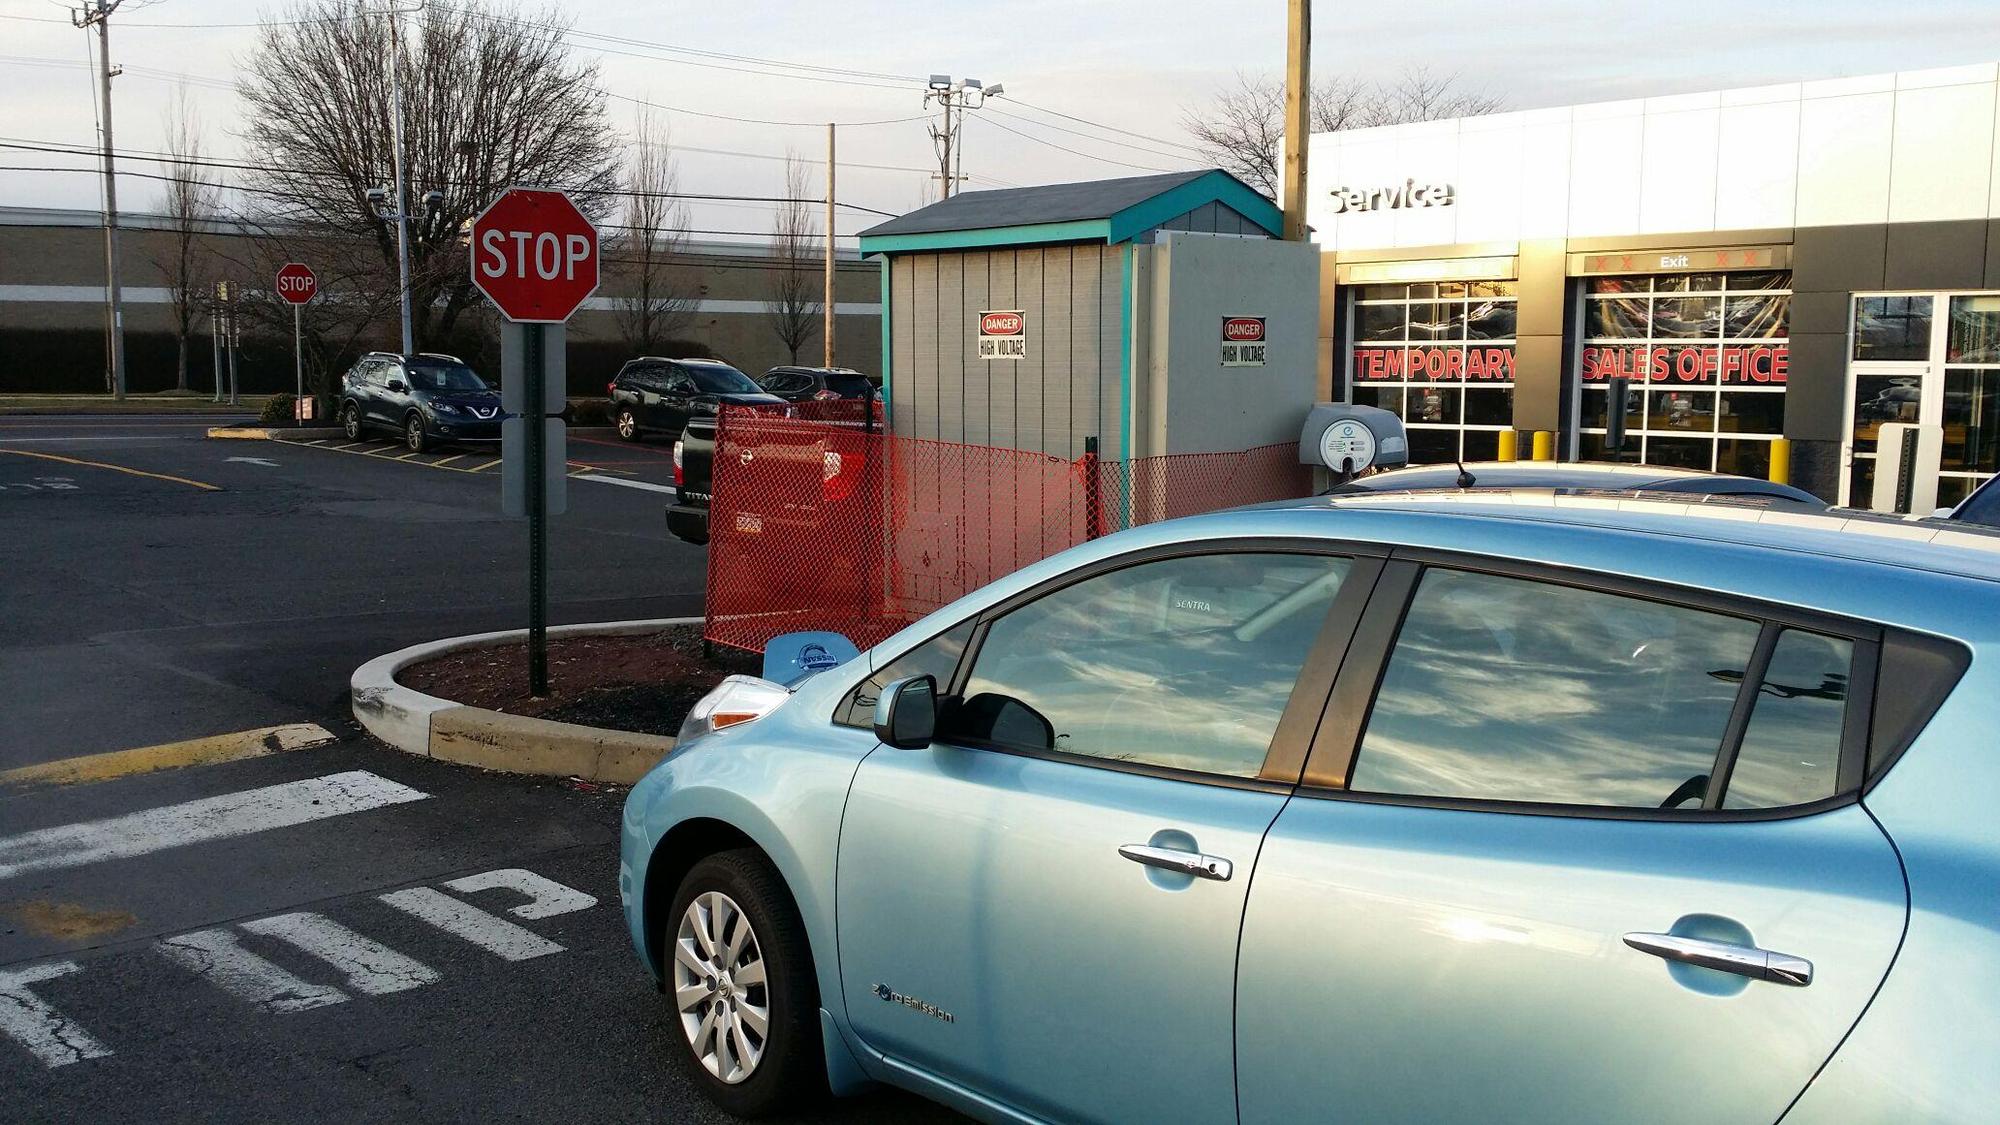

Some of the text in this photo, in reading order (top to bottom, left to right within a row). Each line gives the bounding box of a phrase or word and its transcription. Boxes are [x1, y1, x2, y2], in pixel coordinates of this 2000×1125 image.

[1324, 178, 1455, 213] Service
[481, 228, 591, 281] STOP
[1660, 255, 1689, 268] Exit
[280, 276, 314, 291] STOP
[985, 318, 1018, 330] DANGER
[1228, 323, 1261, 335] DANGER
[980, 340, 1023, 355] HIGH VOLTAGE
[1222, 345, 1265, 362] HIGH VOLTAGE
[1353, 348, 1517, 379] TEMPORARY
[1582, 347, 1789, 383] SALES OFFICE
[1175, 599, 1211, 612] SENTRA
[803, 654, 836, 664] NISSAN
